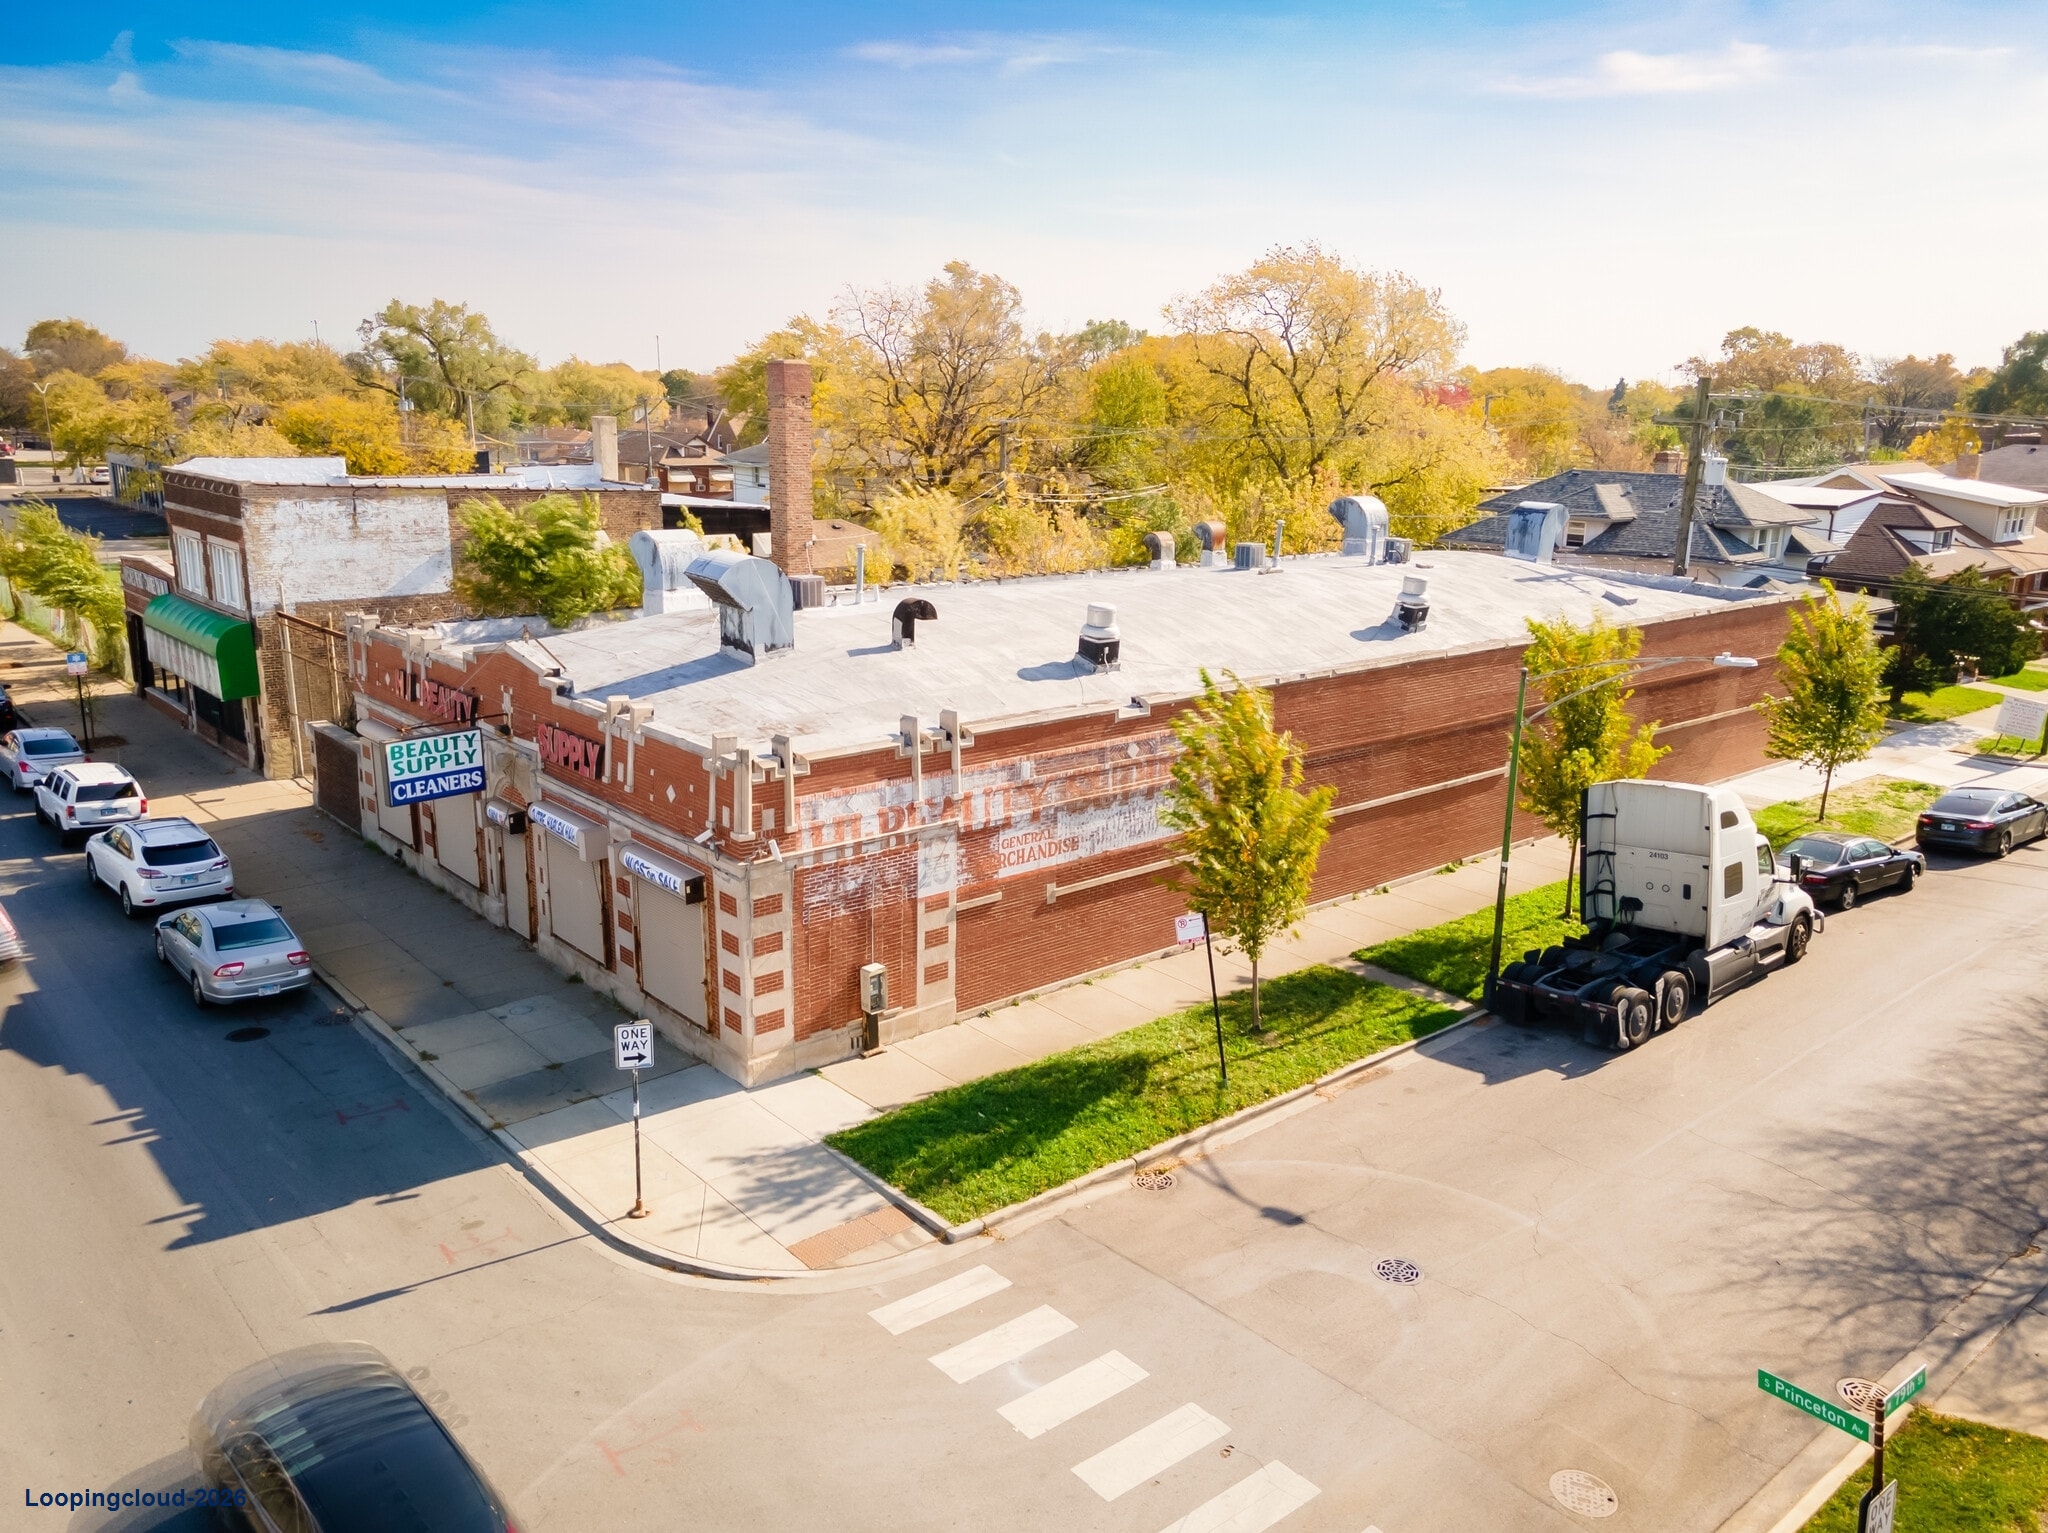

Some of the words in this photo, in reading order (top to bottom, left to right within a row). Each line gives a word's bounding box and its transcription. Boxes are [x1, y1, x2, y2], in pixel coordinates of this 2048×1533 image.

[390, 733, 476, 761] BEAUTY
[537, 723, 600, 780] SUPPLY
[393, 749, 477, 776] SUPPLY
[393, 771, 482, 800] CLEANERS
[1001, 829, 1053, 849] GENERAL
[1649, 851, 1669, 860] 24103
[621, 1028, 648, 1039] ONE
[621, 1040, 648, 1051] WAY
[1895, 1380, 1915, 1406] 79th
[1764, 1378, 1770, 1388] S
[1775, 1381, 1846, 1427] Princeton
[1852, 1423, 1864, 1435] Av
[1871, 1490, 1892, 1521] ONE
[1868, 1508, 1892, 1533] WAY
